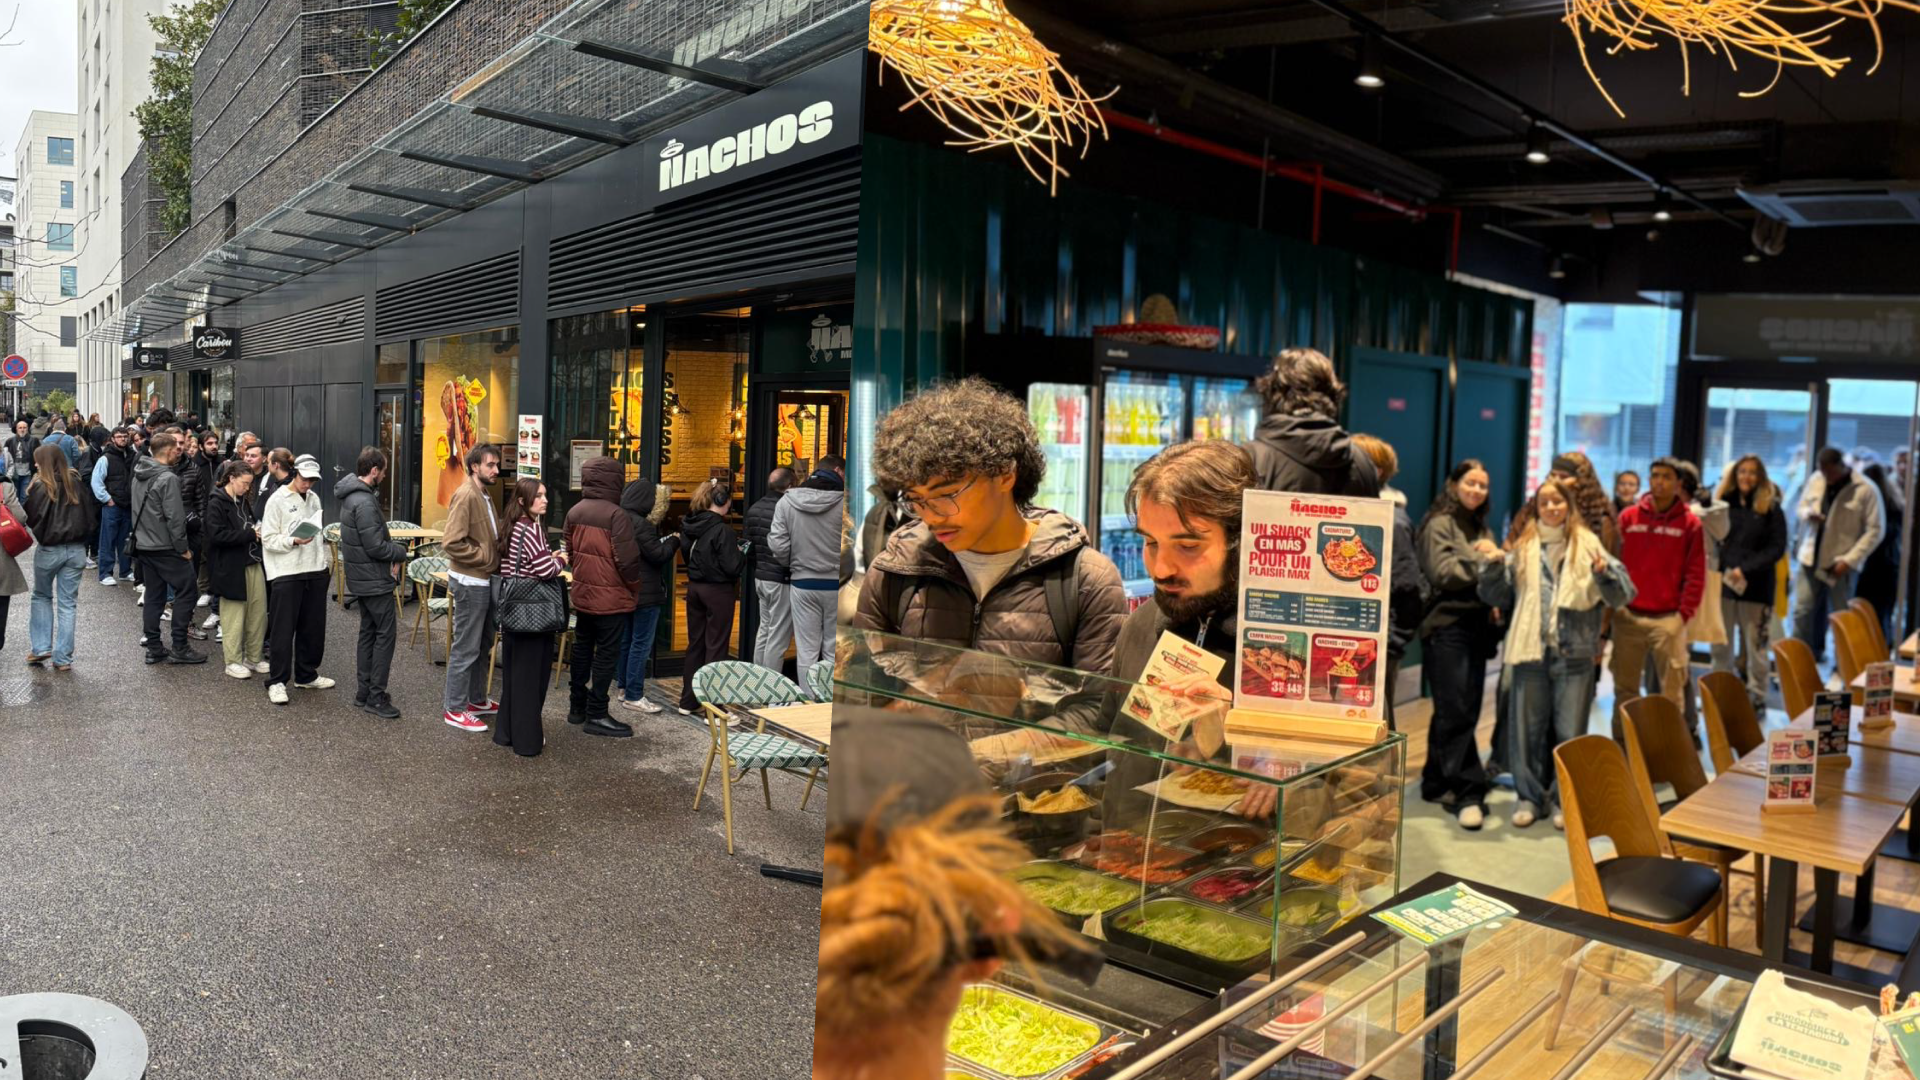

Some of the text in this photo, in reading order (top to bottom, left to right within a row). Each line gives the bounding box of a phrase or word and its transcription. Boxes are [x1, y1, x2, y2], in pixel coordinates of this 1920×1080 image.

[196, 335, 232, 349] Caribou
[1250, 522, 1311, 538] UN SNACK
[1324, 527, 1352, 535] SIGNATURE
[1260, 537, 1301, 551] EN MÁS
[1249, 551, 1311, 570] POUR UN
[1249, 566, 1310, 580] PLAISIR MAX
